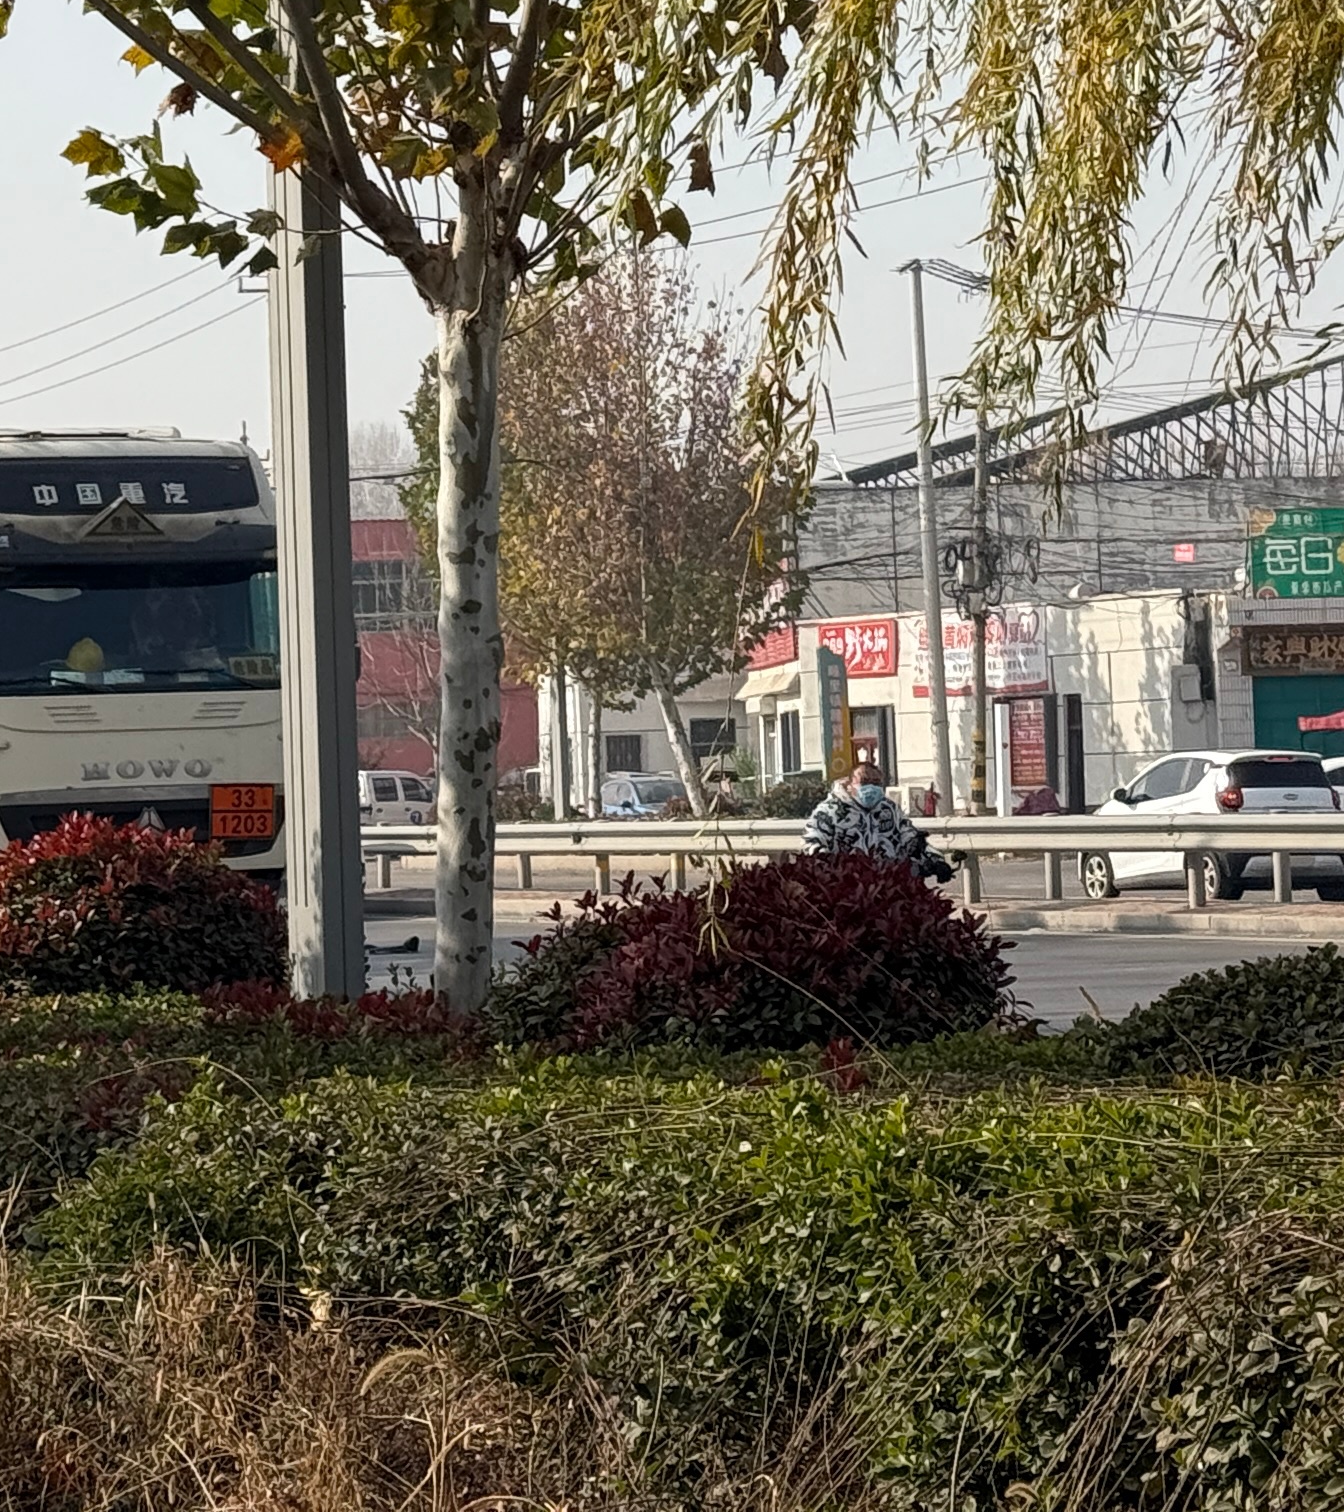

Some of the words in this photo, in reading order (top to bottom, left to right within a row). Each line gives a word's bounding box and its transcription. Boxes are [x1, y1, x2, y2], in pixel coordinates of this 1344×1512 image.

[32, 481, 190, 506] 中国重汽
[81, 758, 212, 781] HOWO
[231, 789, 256, 808] 33
[219, 814, 268, 834] 1203
